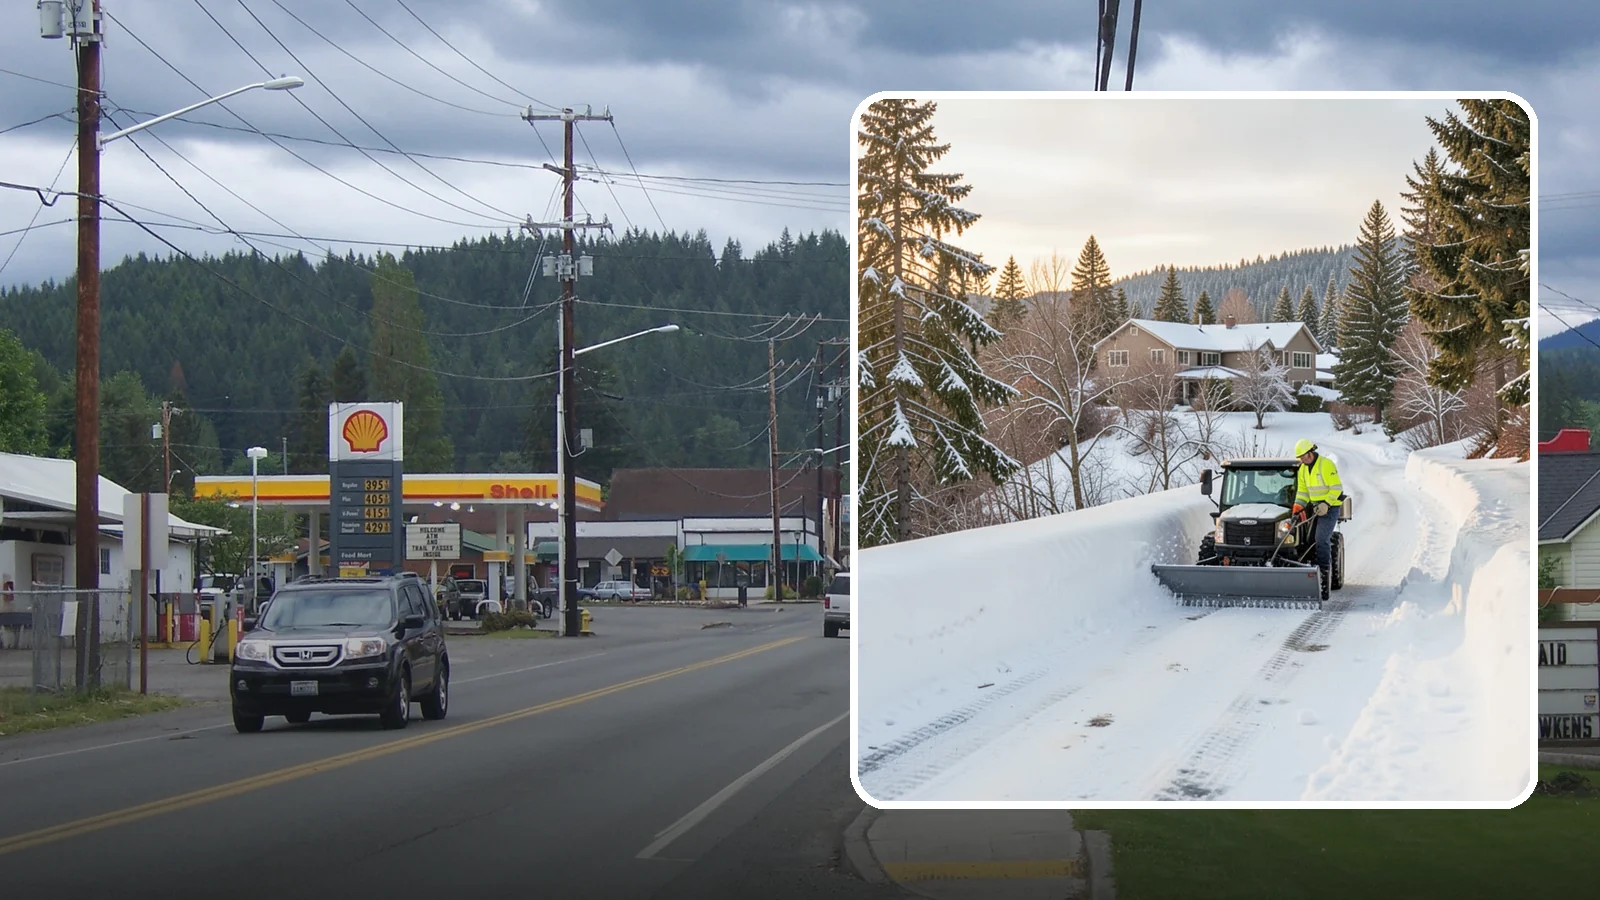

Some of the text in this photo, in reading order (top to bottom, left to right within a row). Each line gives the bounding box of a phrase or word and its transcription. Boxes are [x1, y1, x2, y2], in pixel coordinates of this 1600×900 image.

[366, 480, 383, 490] 395
[490, 484, 547, 499] Shell
[366, 494, 383, 504] 405
[366, 508, 383, 518] 415
[366, 522, 383, 532] 429
